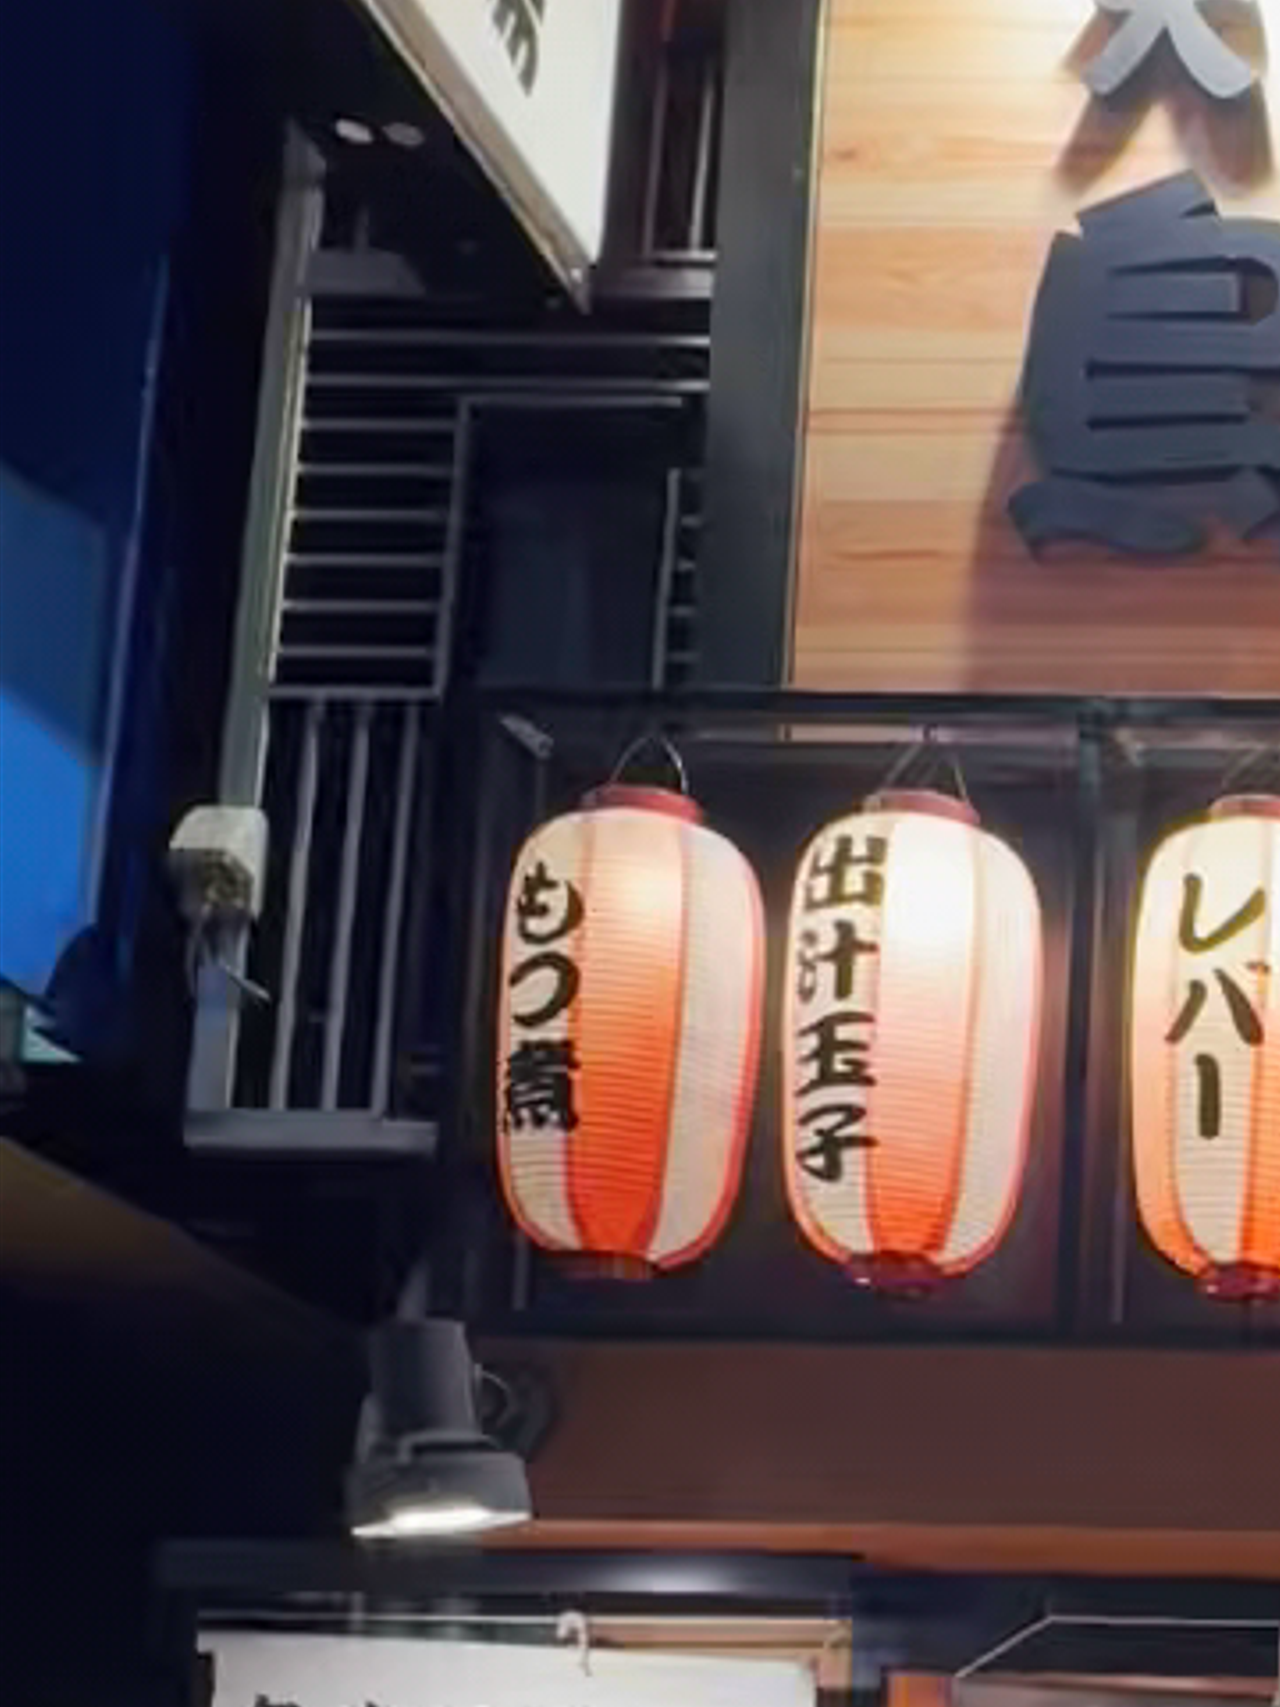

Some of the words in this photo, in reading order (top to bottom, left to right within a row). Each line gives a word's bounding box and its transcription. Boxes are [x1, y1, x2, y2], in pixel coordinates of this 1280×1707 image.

[502, 861, 586, 1134] もつ煮
[794, 834, 888, 1182] 出汁玉子
[1163, 869, 1270, 1141] レバー
